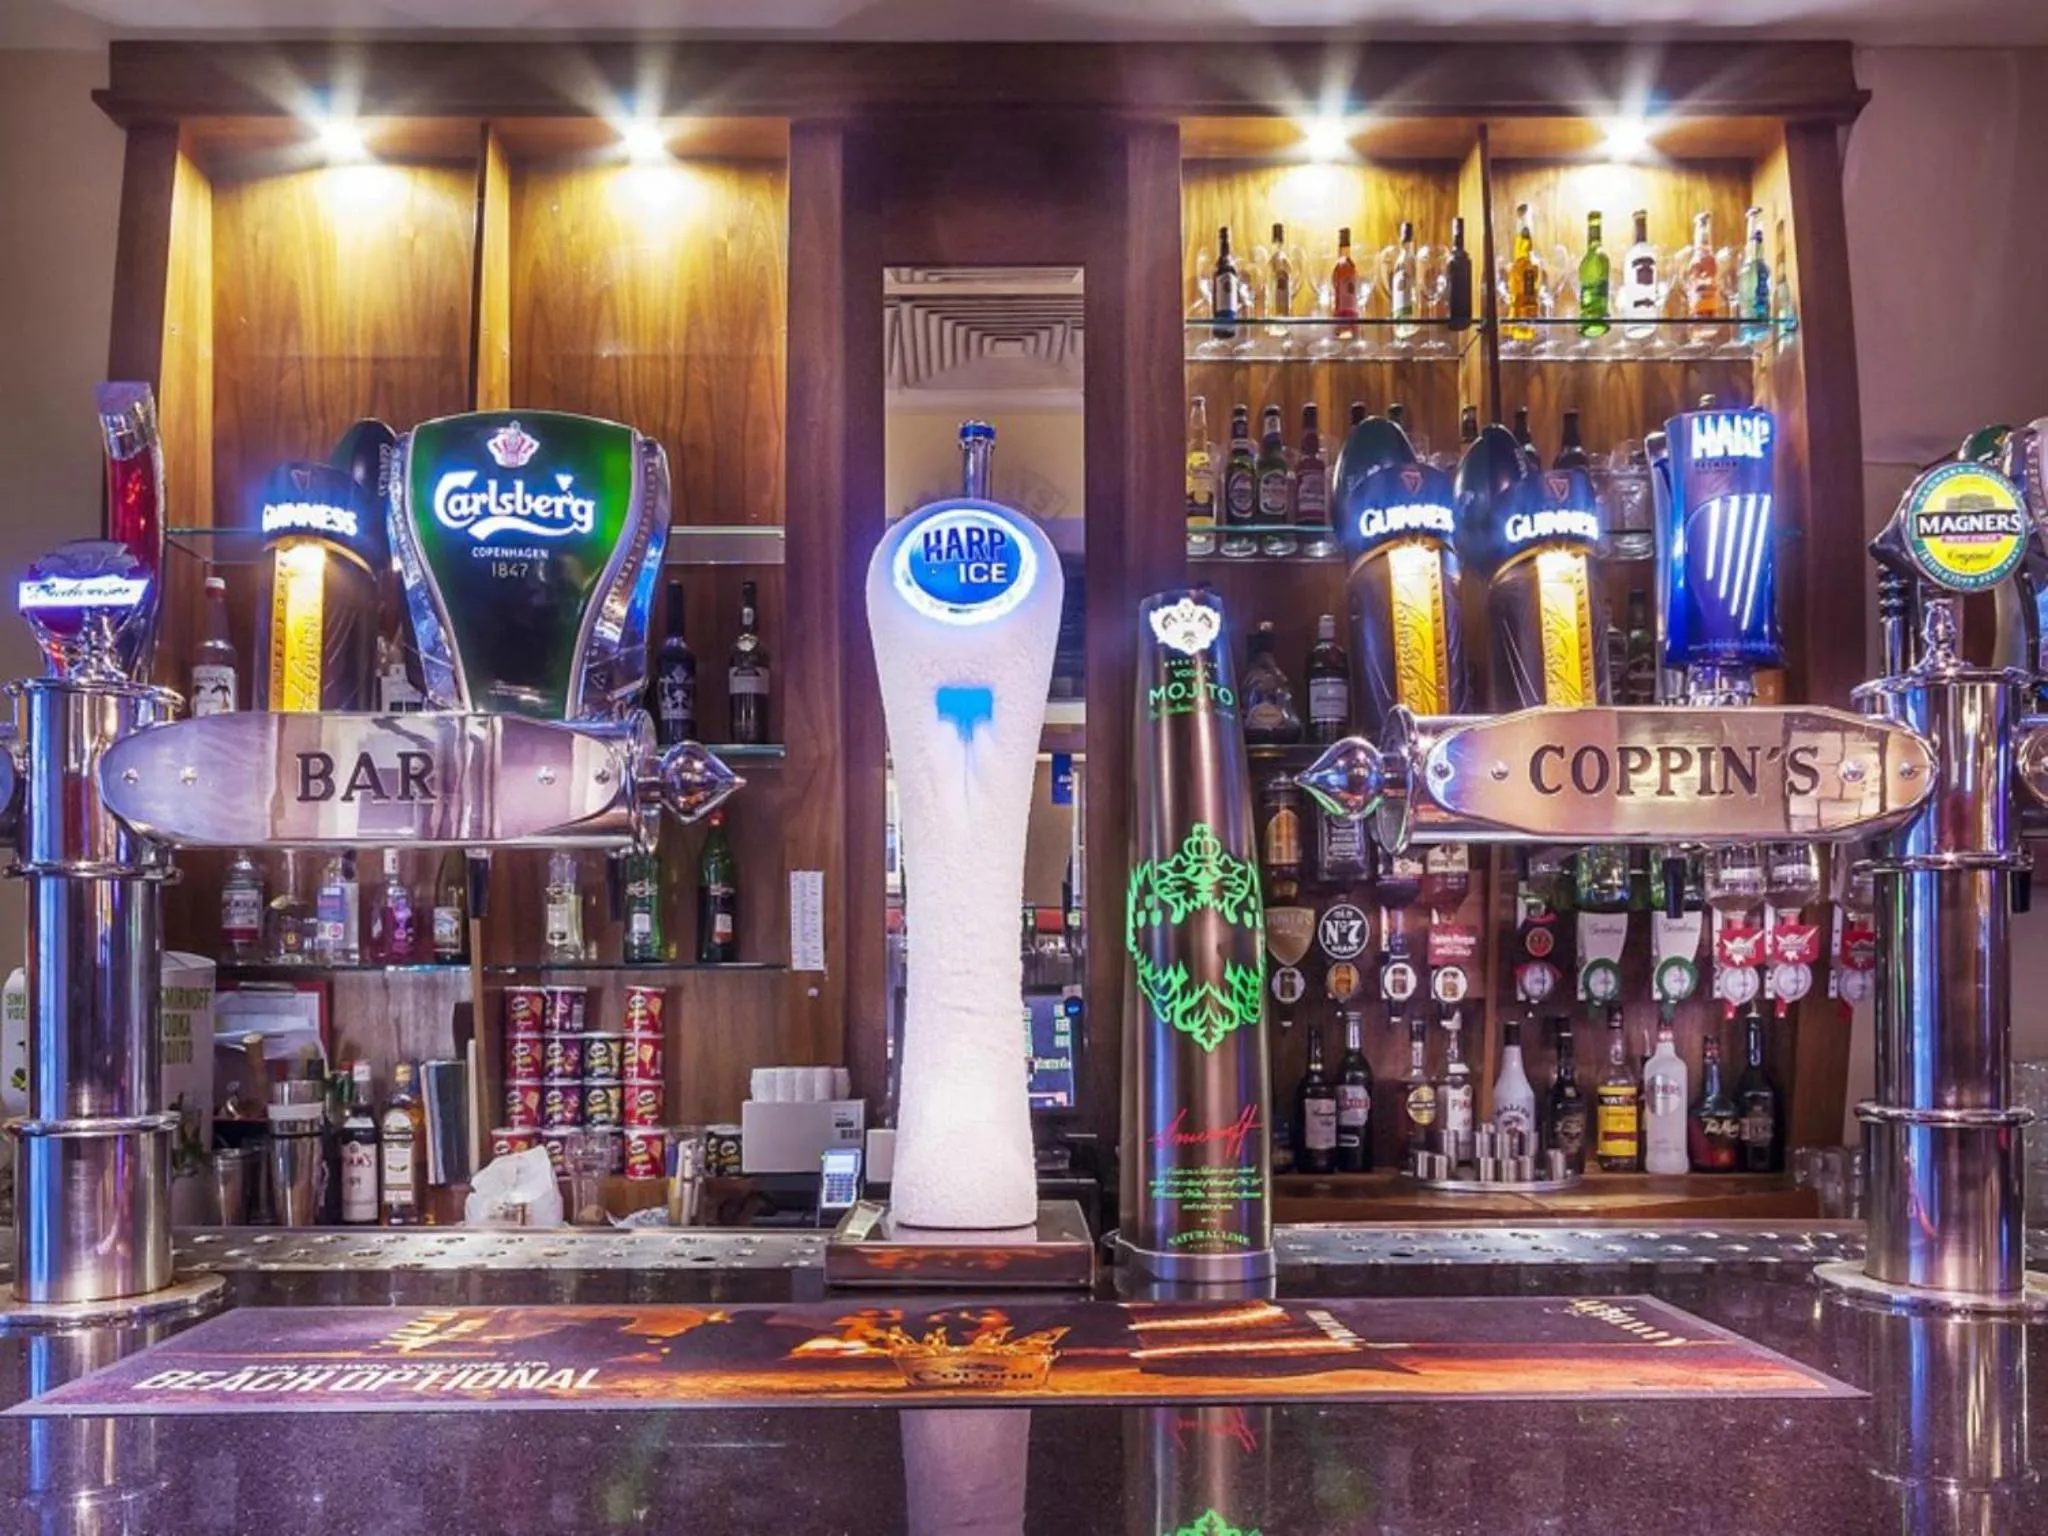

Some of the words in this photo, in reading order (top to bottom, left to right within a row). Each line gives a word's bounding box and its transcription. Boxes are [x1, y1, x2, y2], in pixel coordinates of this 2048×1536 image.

[1691, 413, 1771, 459] HARP
[434, 470, 596, 536] Carlsberg
[1919, 512, 2022, 534] MAGNERS
[471, 546, 549, 559] COPENHAGEN
[922, 526, 1007, 562] HARP
[491, 561, 529, 579] 1847
[958, 562, 1008, 584] ICE
[1148, 682, 1234, 706] MOJITO
[295, 751, 438, 802] BAR
[1528, 744, 1819, 796] COPPIN'S
[131, 1370, 337, 1392] BEACH
[328, 1368, 601, 1391] OPTIONAL
